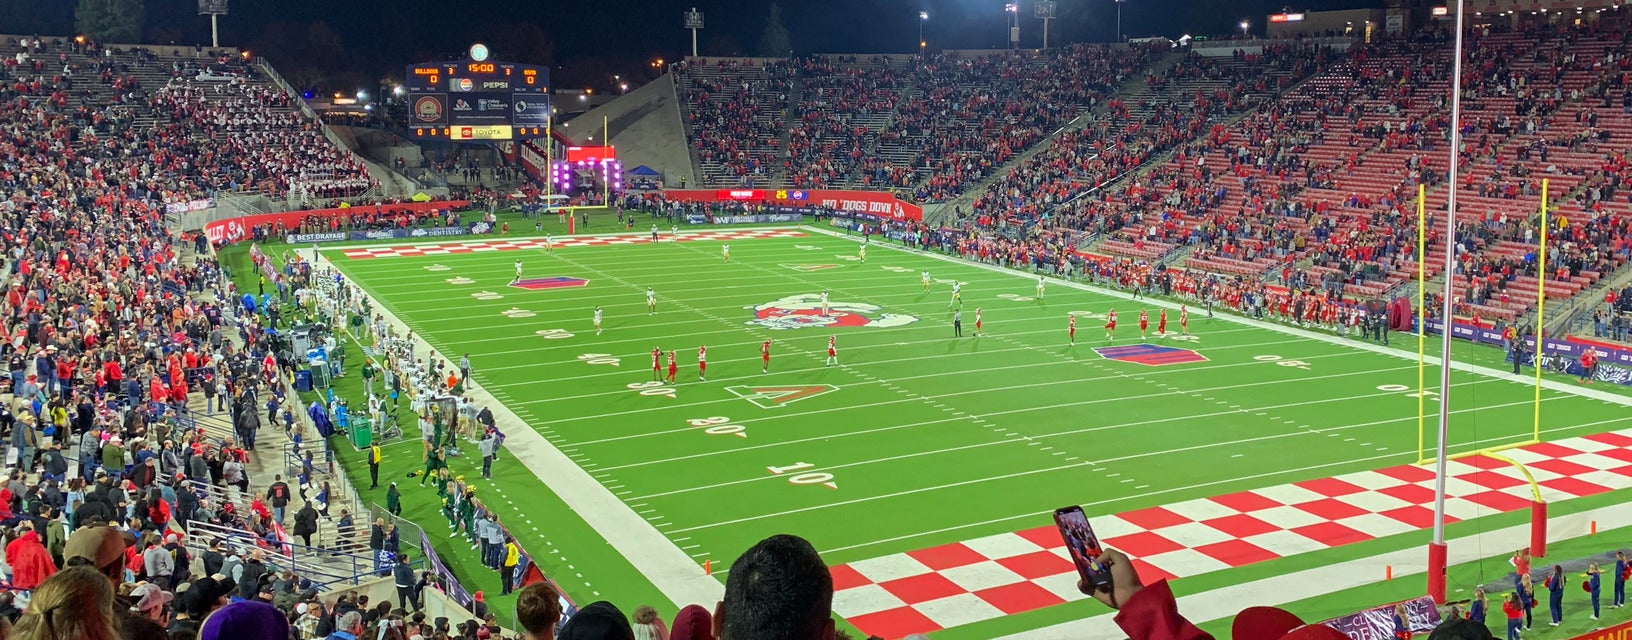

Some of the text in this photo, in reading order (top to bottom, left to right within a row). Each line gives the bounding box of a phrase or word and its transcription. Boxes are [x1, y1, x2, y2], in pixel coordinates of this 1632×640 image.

[448, 67, 454, 75] 3
[468, 63, 494, 72] 15:00
[505, 68, 511, 76] 3
[430, 75, 438, 83] 0
[527, 76, 534, 84] 0
[776, 190, 787, 199] 25
[868, 202, 891, 214] DOWN
[315, 232, 346, 240] DRAYAGE
[626, 381, 677, 398] 30
[686, 416, 748, 438] 20
[766, 461, 838, 490] 10
